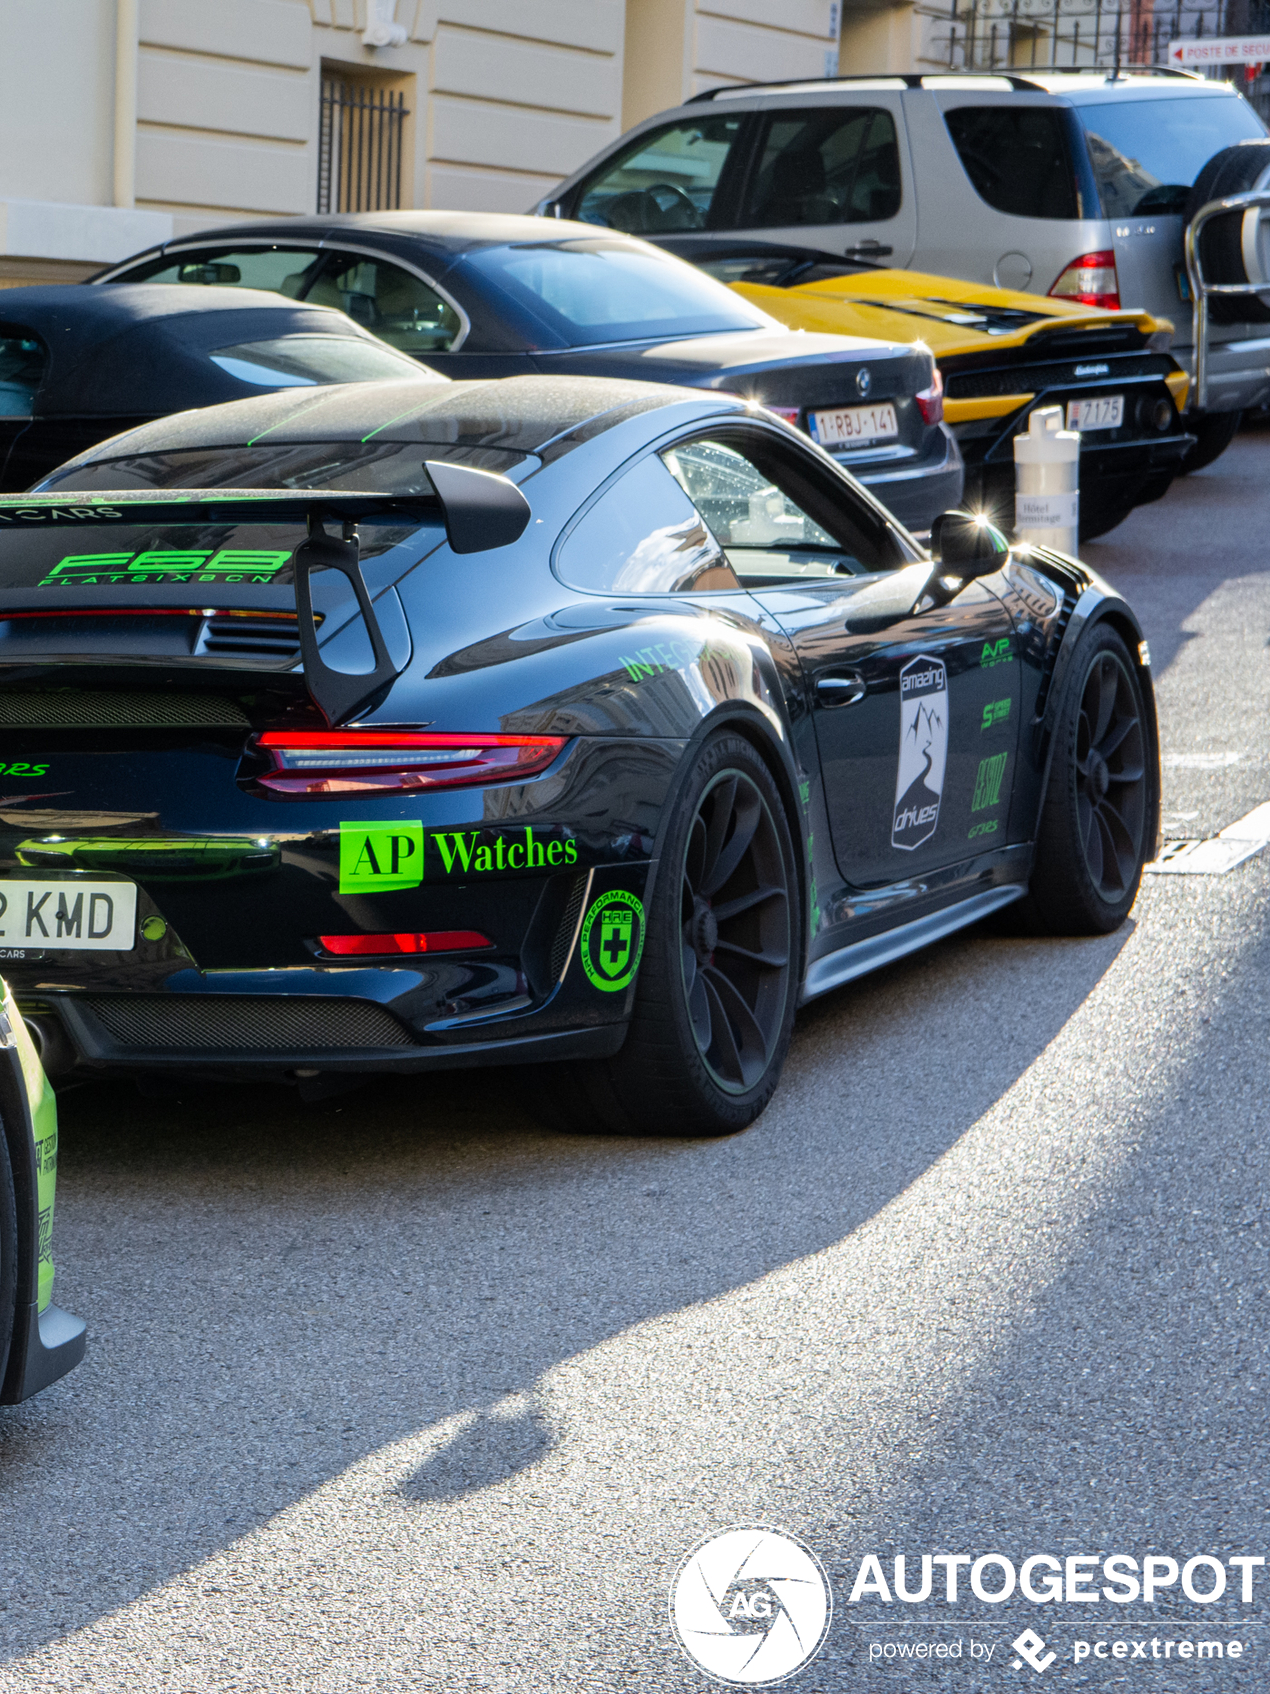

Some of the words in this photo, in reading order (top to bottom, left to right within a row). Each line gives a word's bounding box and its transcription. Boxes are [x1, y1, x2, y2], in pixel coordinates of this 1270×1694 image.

[1187, 46, 1221, 59] POSTE
[1225, 45, 1239, 57] DE
[15, 507, 123, 521] CARS
[1023, 503, 1049, 514] Hôtel
[38, 574, 273, 587] FLATSIXBCN
[981, 637, 1010, 660] AVP
[902, 667, 944, 692] amazing
[895, 804, 938, 832] drives
[349, 835, 416, 875] AP
[430, 826, 578, 874] Watches
[25, 891, 114, 939] KMD
[603, 912, 632, 923] HRE
[0, 949, 26, 959] CARS
